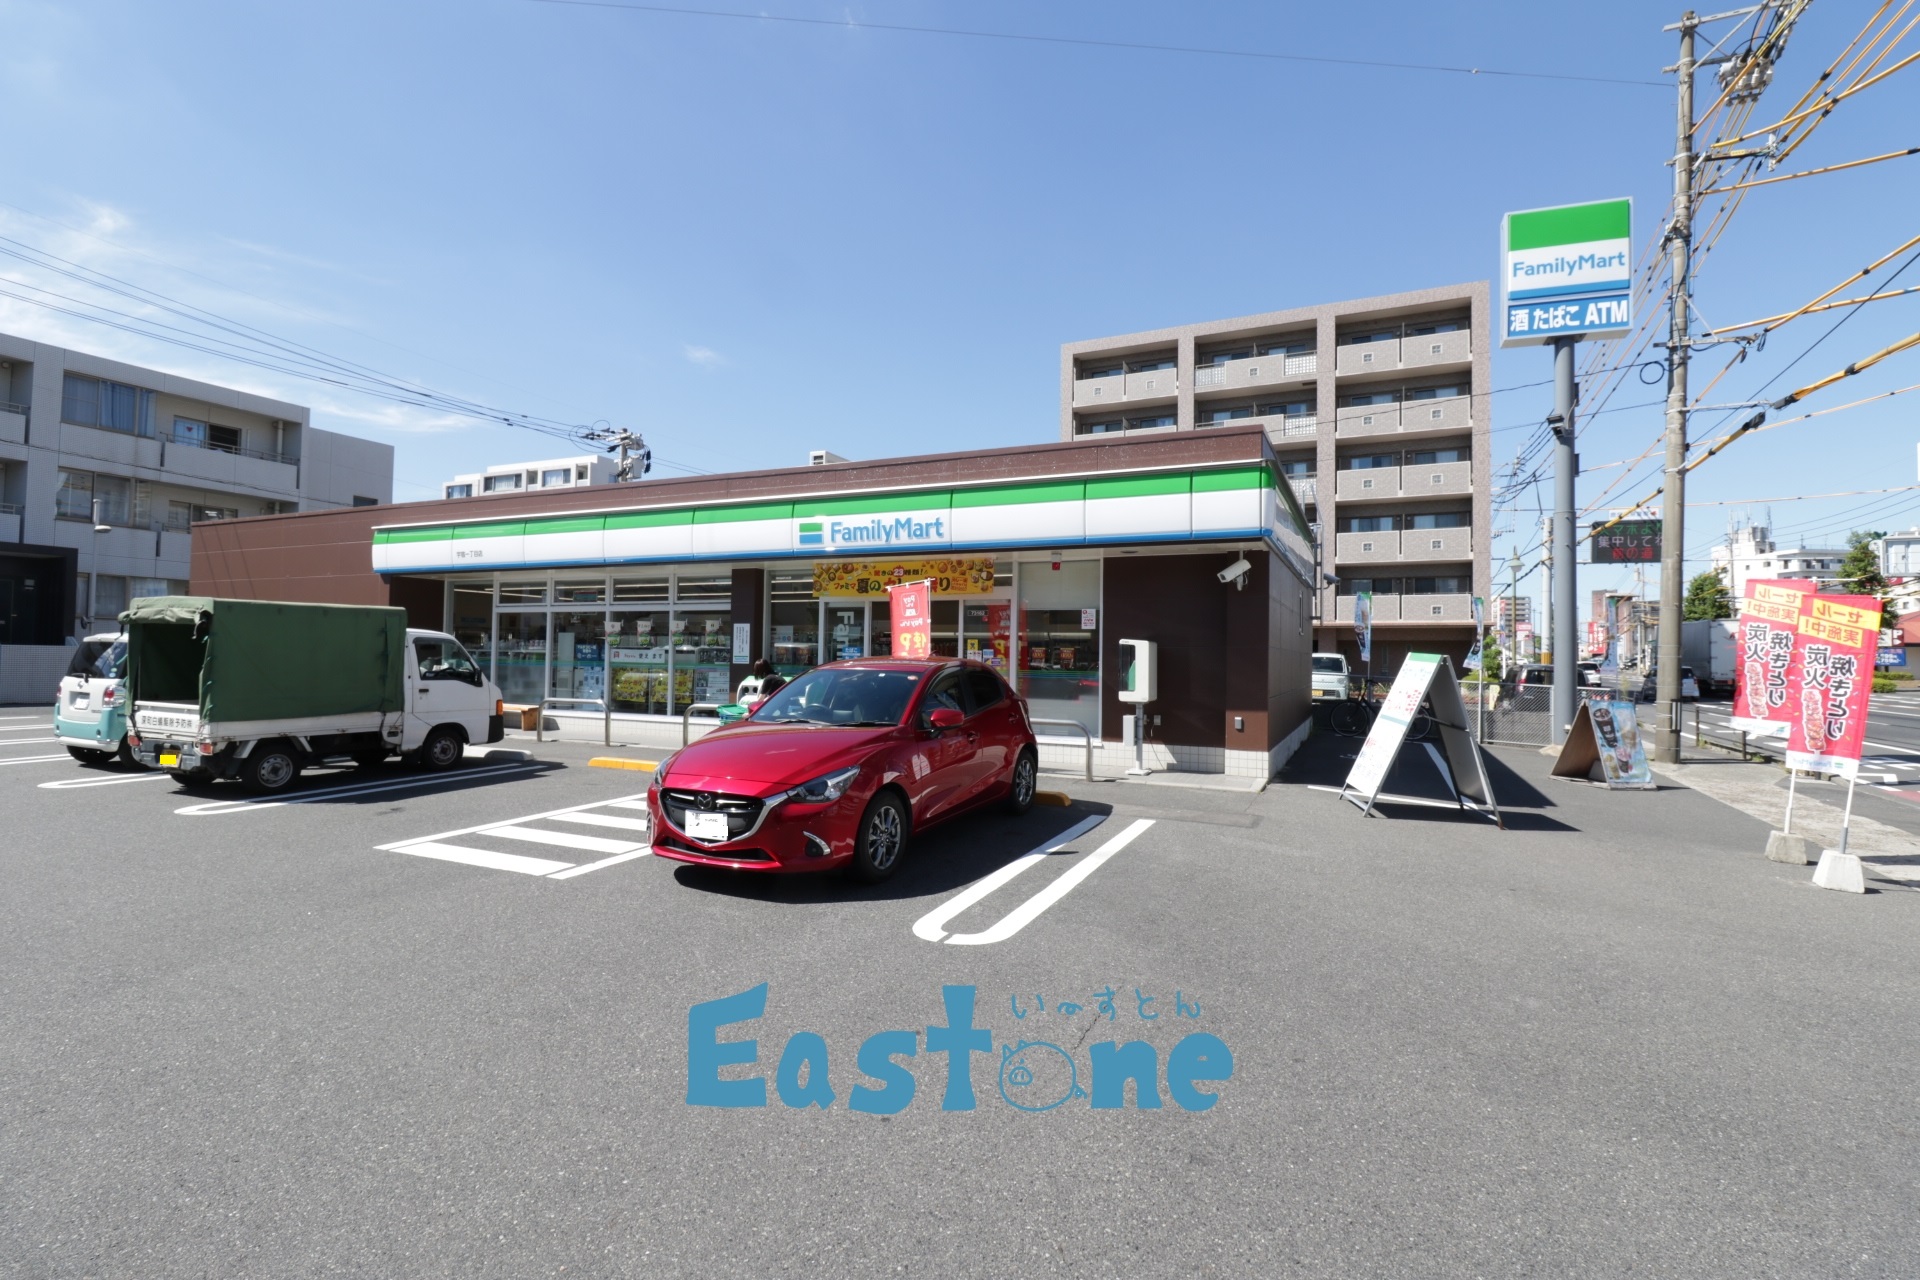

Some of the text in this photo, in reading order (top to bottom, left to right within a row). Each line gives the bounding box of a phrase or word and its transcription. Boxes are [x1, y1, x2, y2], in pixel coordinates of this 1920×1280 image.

[1513, 252, 1625, 277] FamilyMart
[1510, 300, 1628, 332] 酒 たばこ ATM
[831, 517, 944, 543] FamilyMart
